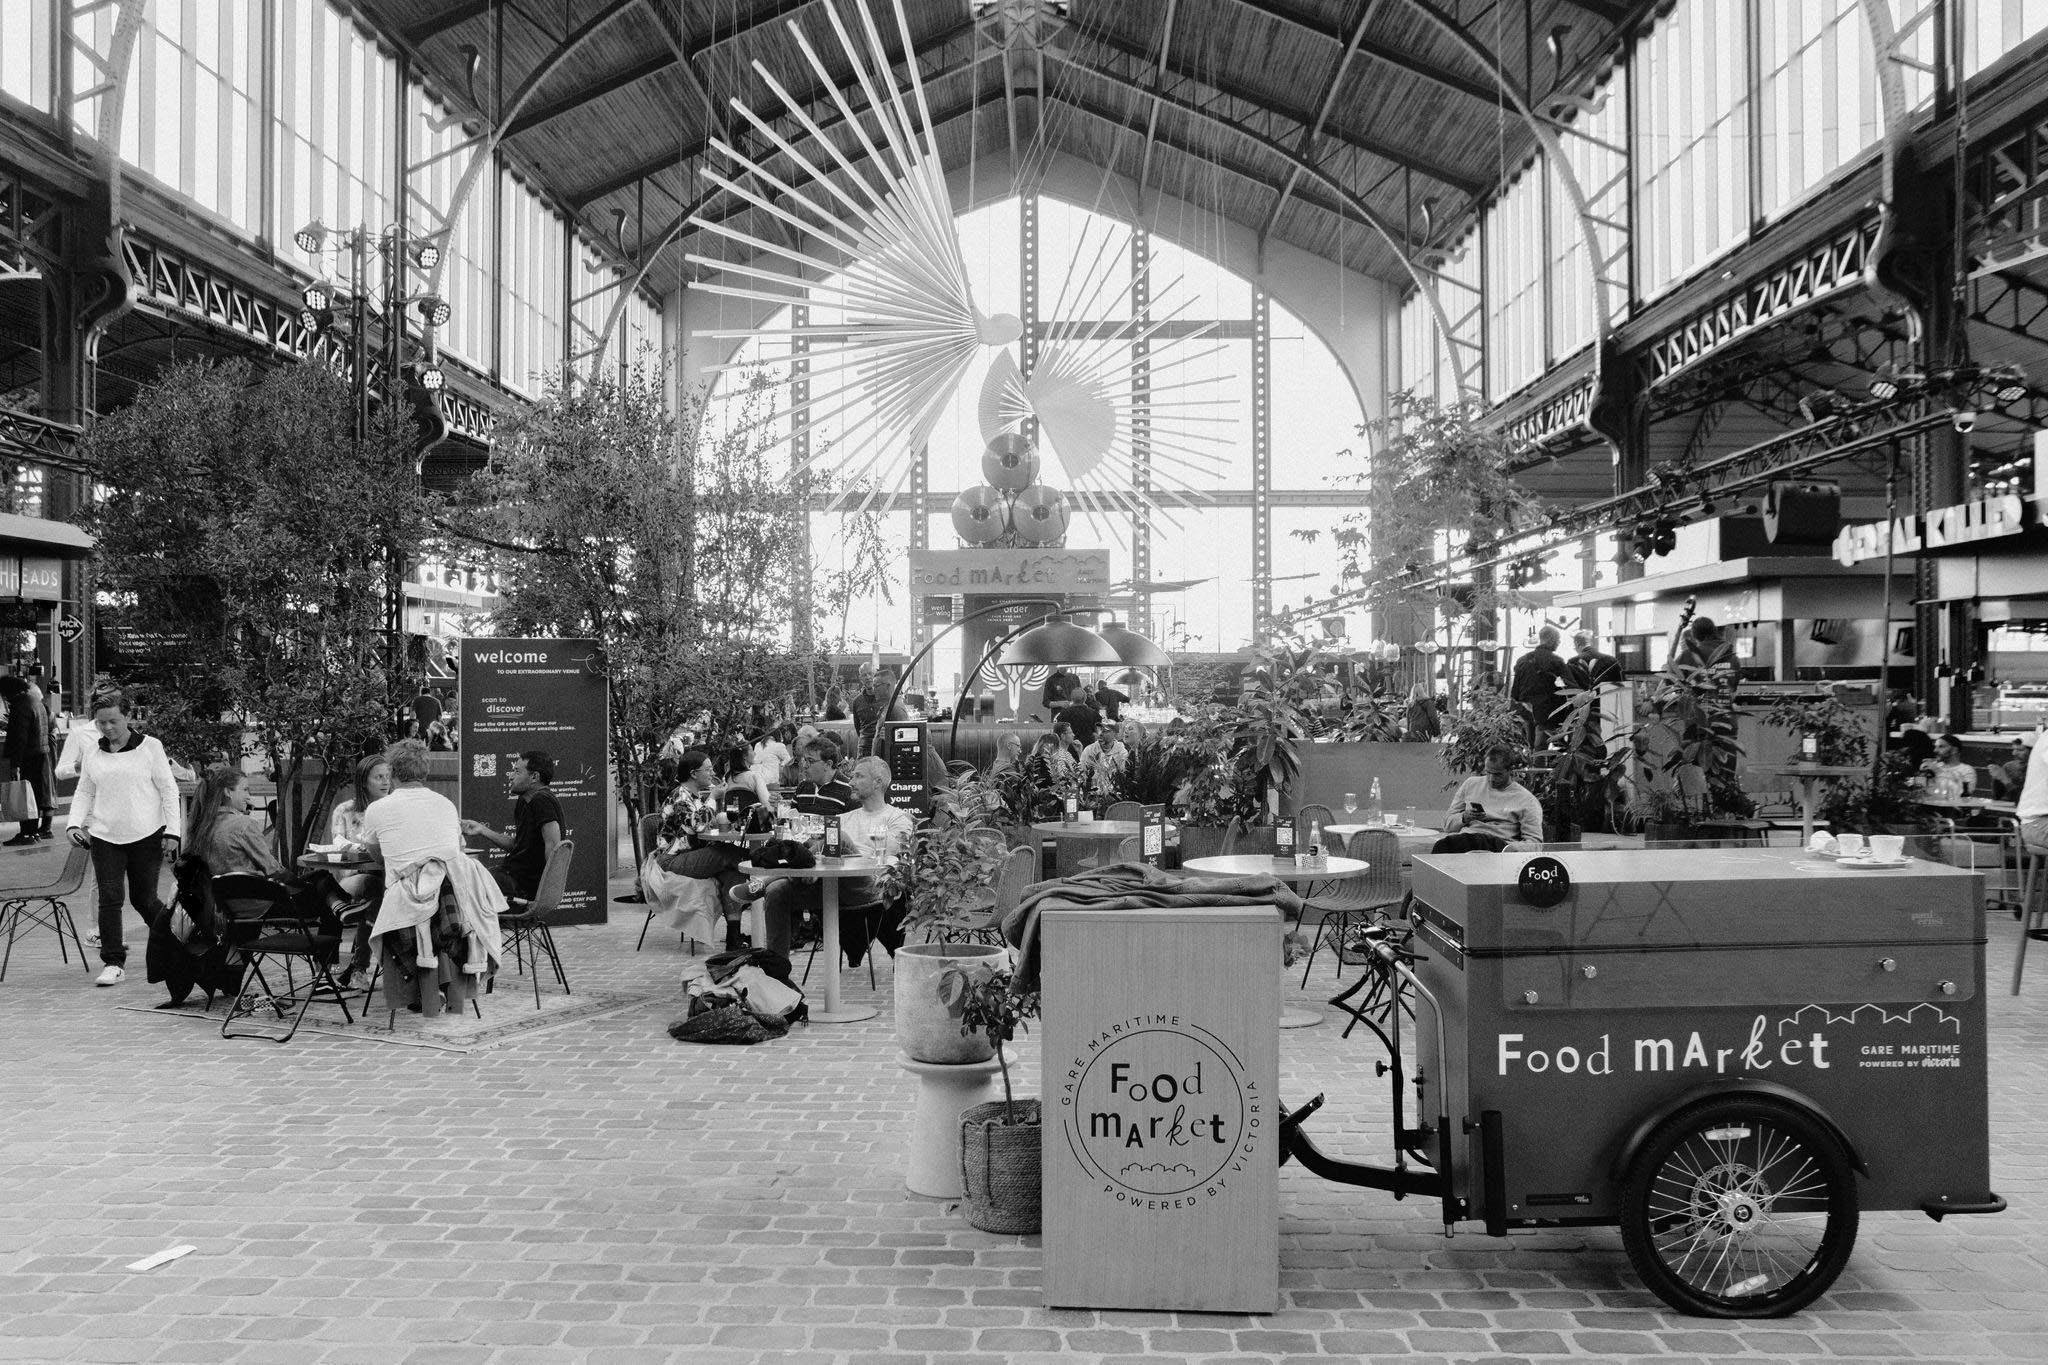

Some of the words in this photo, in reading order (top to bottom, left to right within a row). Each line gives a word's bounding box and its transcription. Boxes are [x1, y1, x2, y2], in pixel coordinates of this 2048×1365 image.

[1926, 494, 2024, 549] KILLER
[912, 566, 961, 586] Food
[1003, 605, 1029, 614] order
[60, 620, 79, 629] PICK
[474, 649, 548, 664] welcome
[486, 704, 526, 714] discover
[890, 783, 923, 792] Charge
[890, 796, 912, 804] your
[1528, 865, 1558, 881] Food
[1498, 1033, 1614, 1076] Food
[1633, 1014, 1831, 1074] mArket
[1860, 1045, 1894, 1055] GARE
[1901, 1044, 1961, 1055] MARITIME
[1061, 1057, 1086, 1106] GARE
[1088, 1014, 1181, 1052] MARITIME
[1907, 1060, 1919, 1068] BY
[1921, 1055, 1961, 1068] victoria
[1111, 1061, 1205, 1104] Food
[1090, 1104, 1226, 1149] mArket
[1103, 1185, 1197, 1211] POWERED
[1206, 1177, 1228, 1197] BY
[1231, 1081, 1261, 1174] VICTORIA
